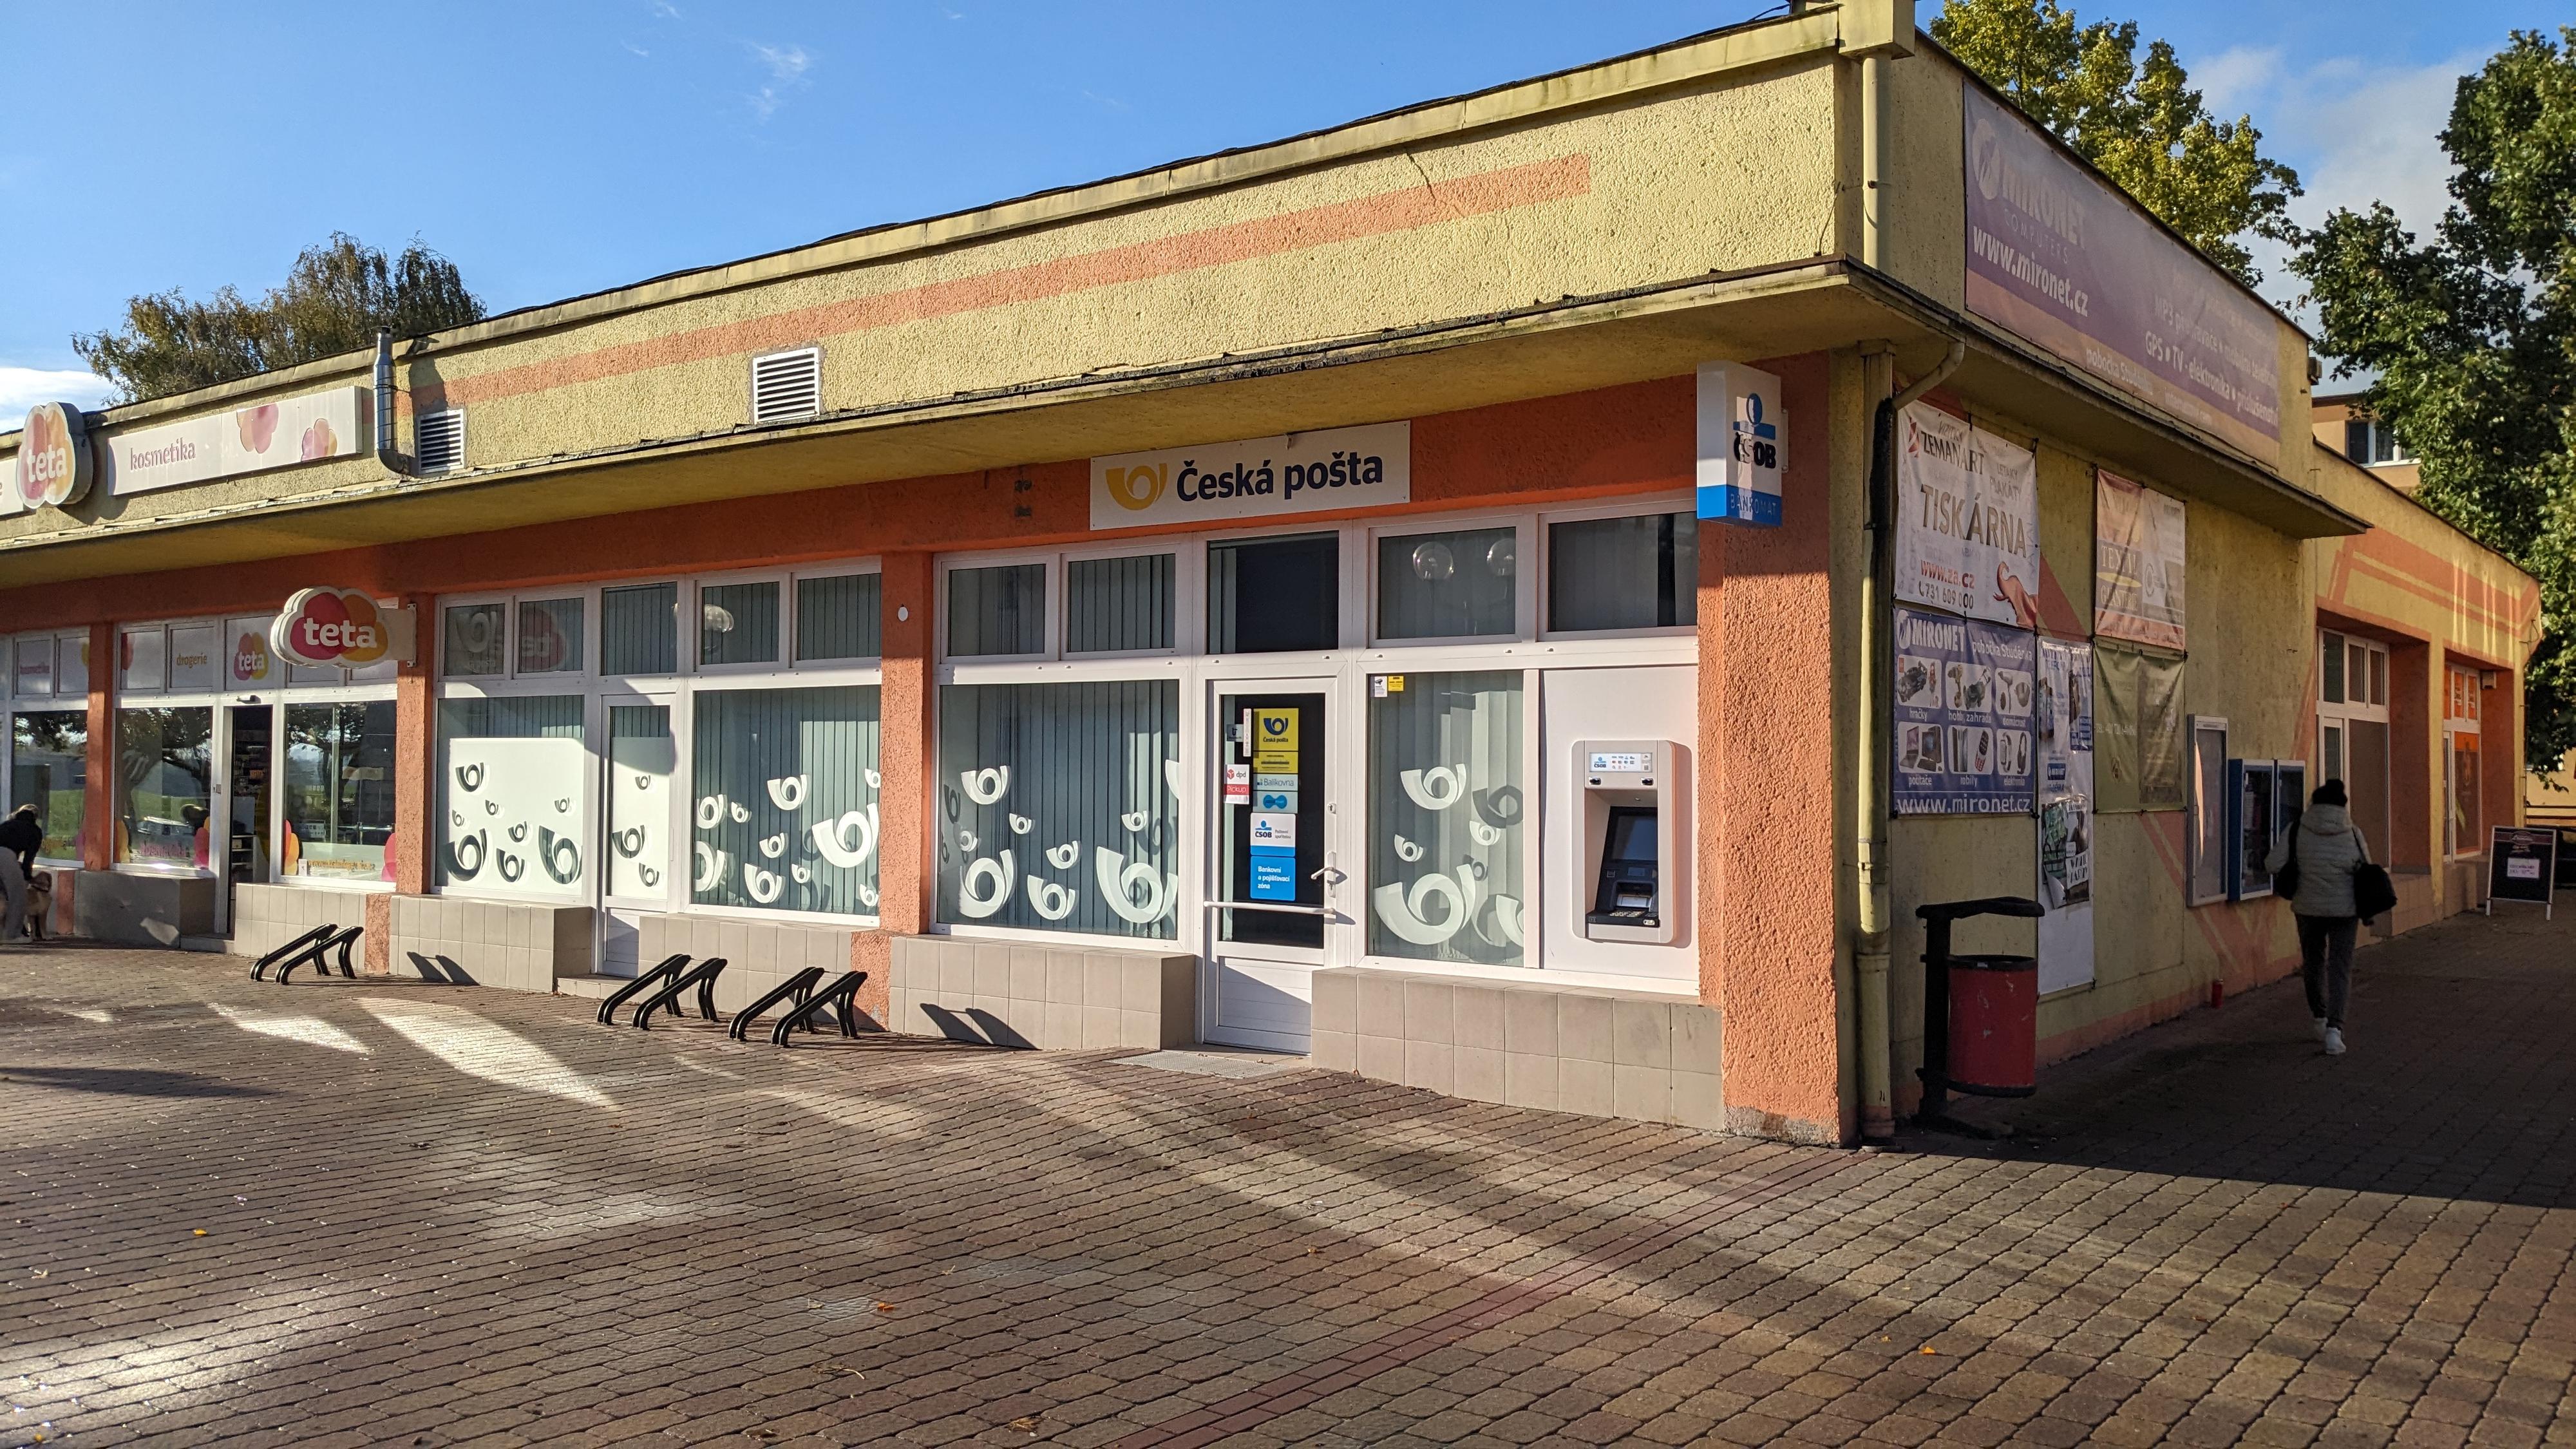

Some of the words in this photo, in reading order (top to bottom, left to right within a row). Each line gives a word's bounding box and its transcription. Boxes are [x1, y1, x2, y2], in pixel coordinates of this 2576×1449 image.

[1973, 225, 2088, 317] www.mironet.cz
[2145, 330, 2163, 362] GPS
[2173, 345, 2184, 372] TV
[2190, 357, 2230, 401] elektronika
[26, 444, 67, 482] teta
[130, 438, 196, 471] kosmetika
[1734, 432, 1776, 469] ČSOB
[1177, 460, 1273, 502] Česká
[1284, 451, 1383, 500] pošta
[1730, 493, 1777, 515] BANKOMAT
[1921, 484, 2026, 558] TISKÁRNA
[1921, 560, 1975, 589] www.za.cz
[1925, 583, 1939, 600] 731
[1958, 592, 1974, 609] 000
[303, 617, 378, 648] teta
[1912, 618, 1965, 652] MIRONET
[176, 652, 207, 668] drogerie
[238, 650, 265, 671] teta
[1967, 713, 1992, 723] zahrada
[1236, 771, 1246, 779] dpd
[1897, 793, 2031, 814] www.mironet.cz
